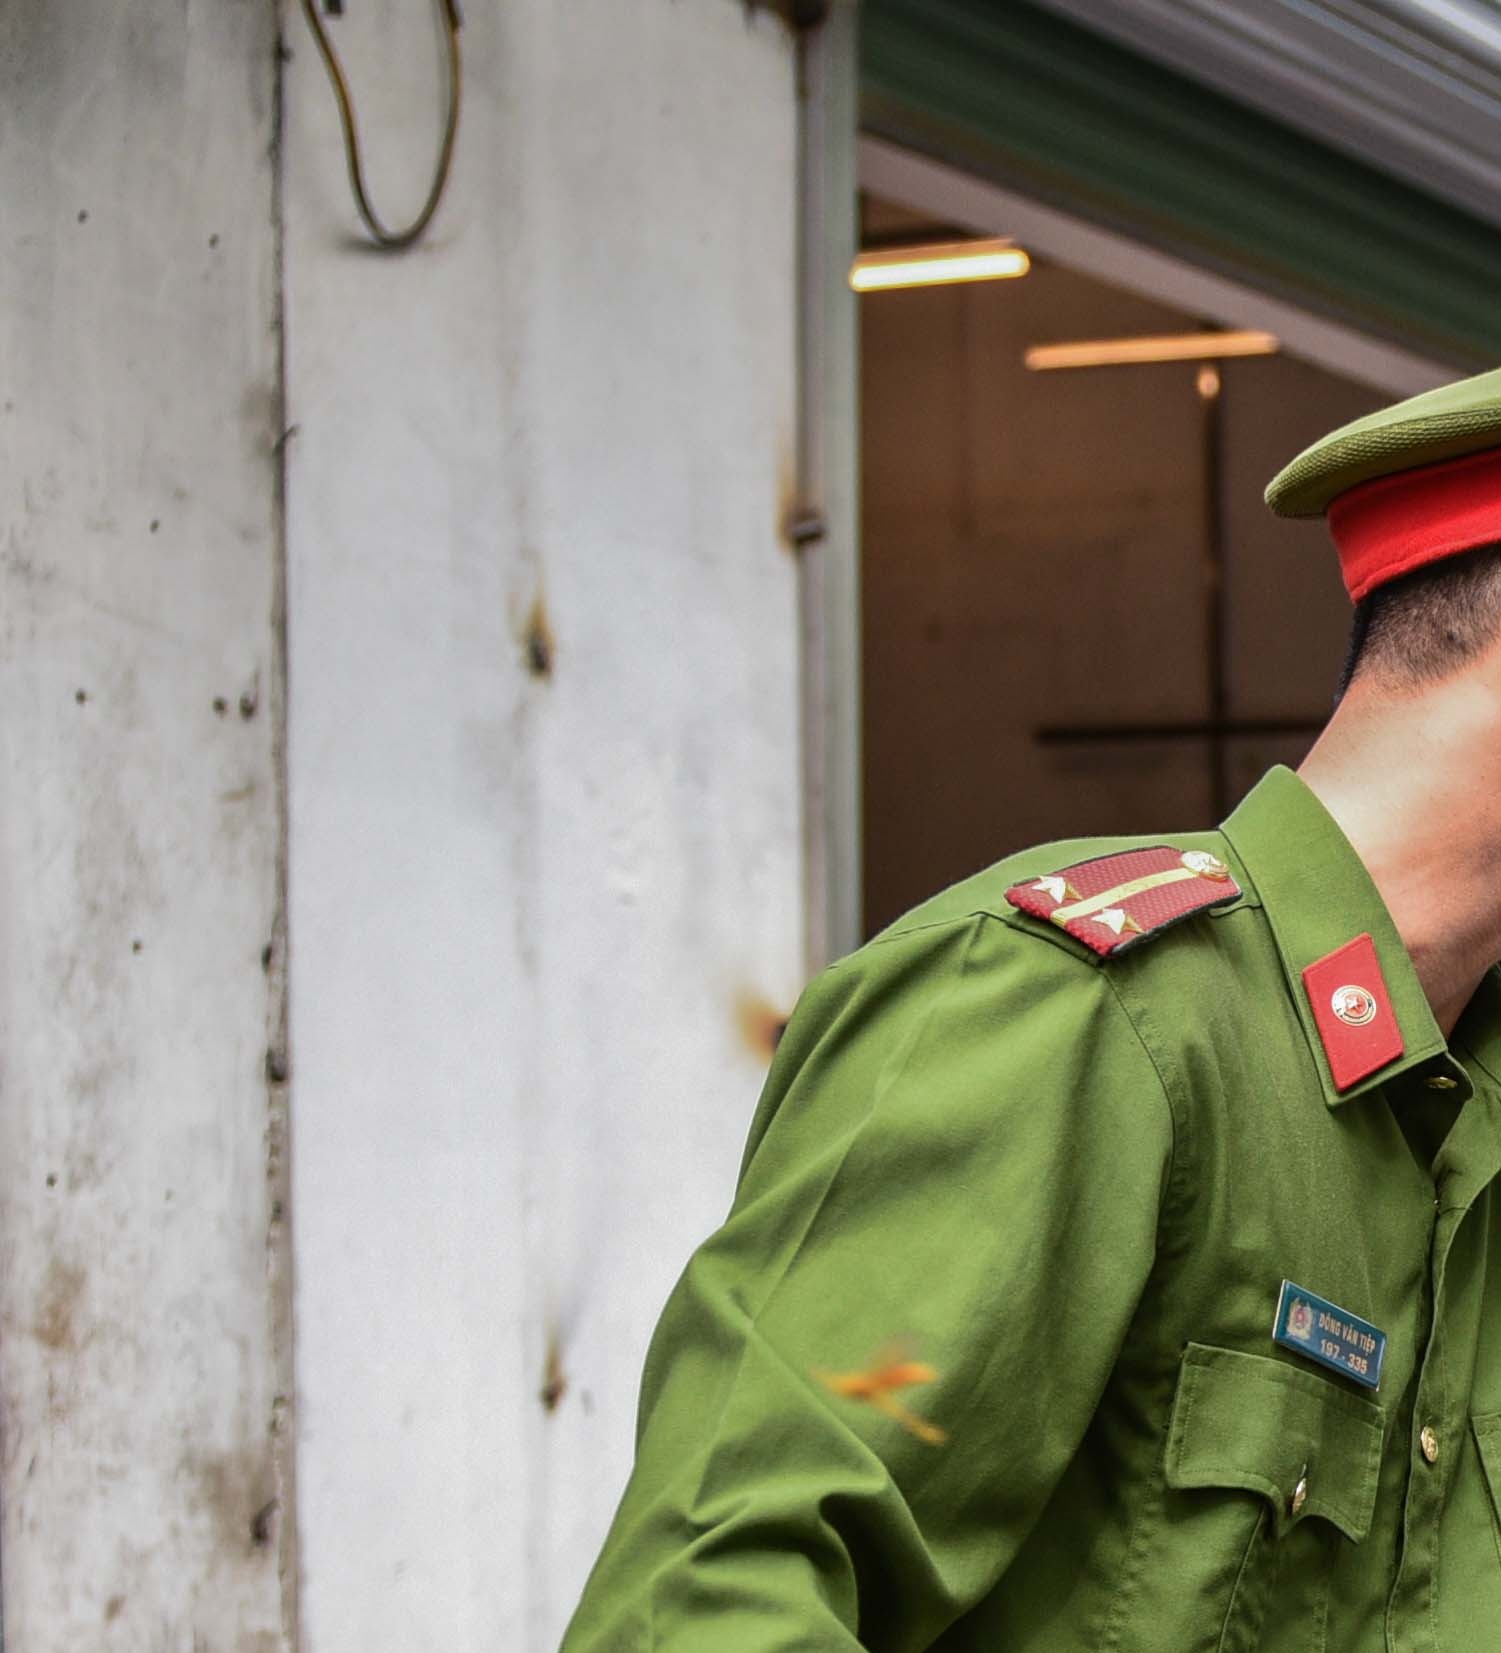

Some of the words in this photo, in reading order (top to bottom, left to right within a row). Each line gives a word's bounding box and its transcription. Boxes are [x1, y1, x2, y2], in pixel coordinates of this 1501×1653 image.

[1342, 1323, 1360, 1346] VĂN
[1321, 1338, 1340, 1360] 197
[1347, 1352, 1369, 1375] 335
